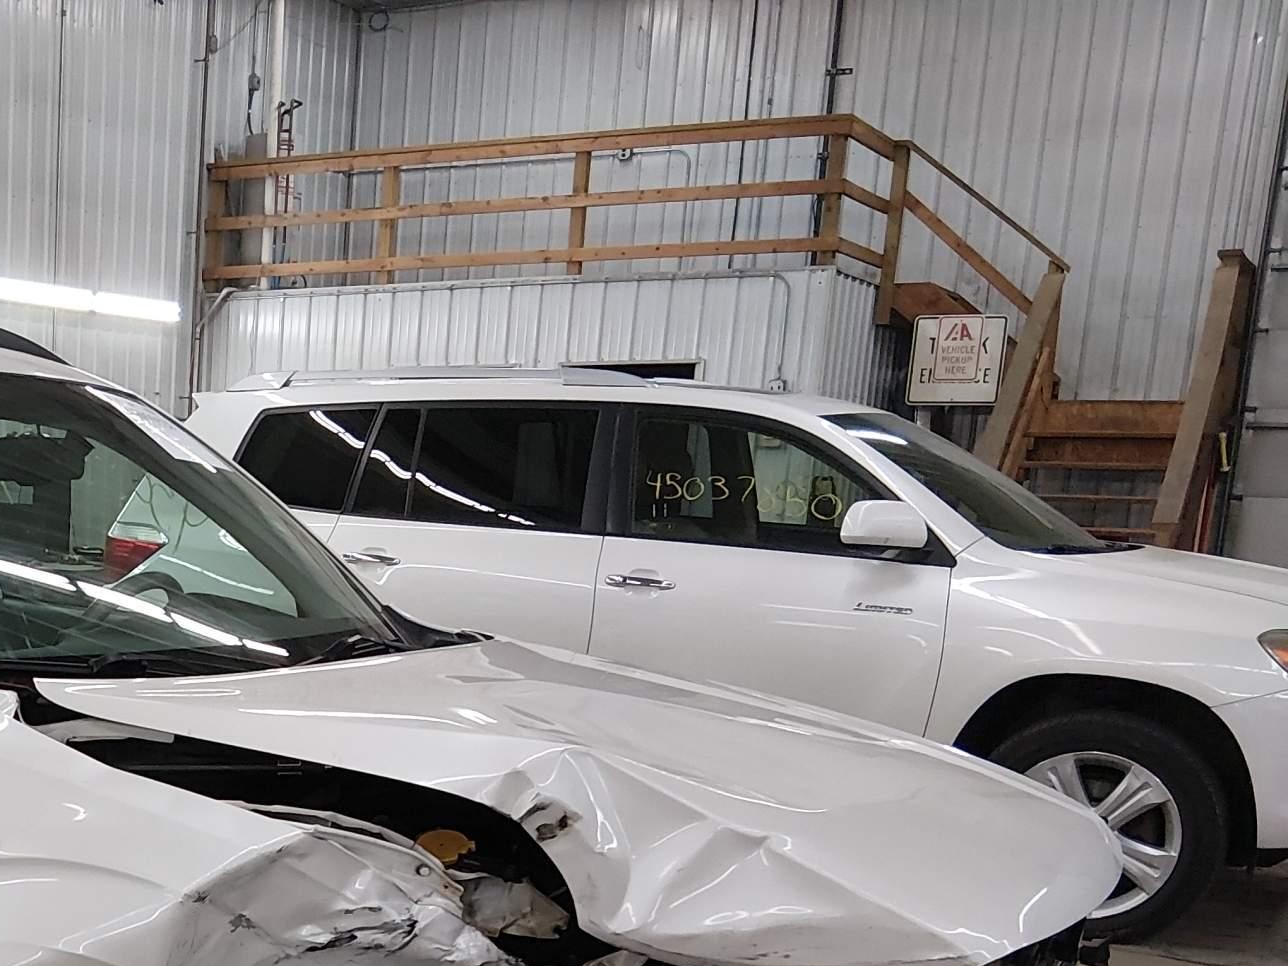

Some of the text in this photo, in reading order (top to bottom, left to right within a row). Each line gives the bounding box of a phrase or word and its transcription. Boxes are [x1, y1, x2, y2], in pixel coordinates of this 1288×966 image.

[941, 345, 976, 354] VEHICLE
[941, 355, 974, 364] PICKUP
[945, 365, 967, 375] HERE
